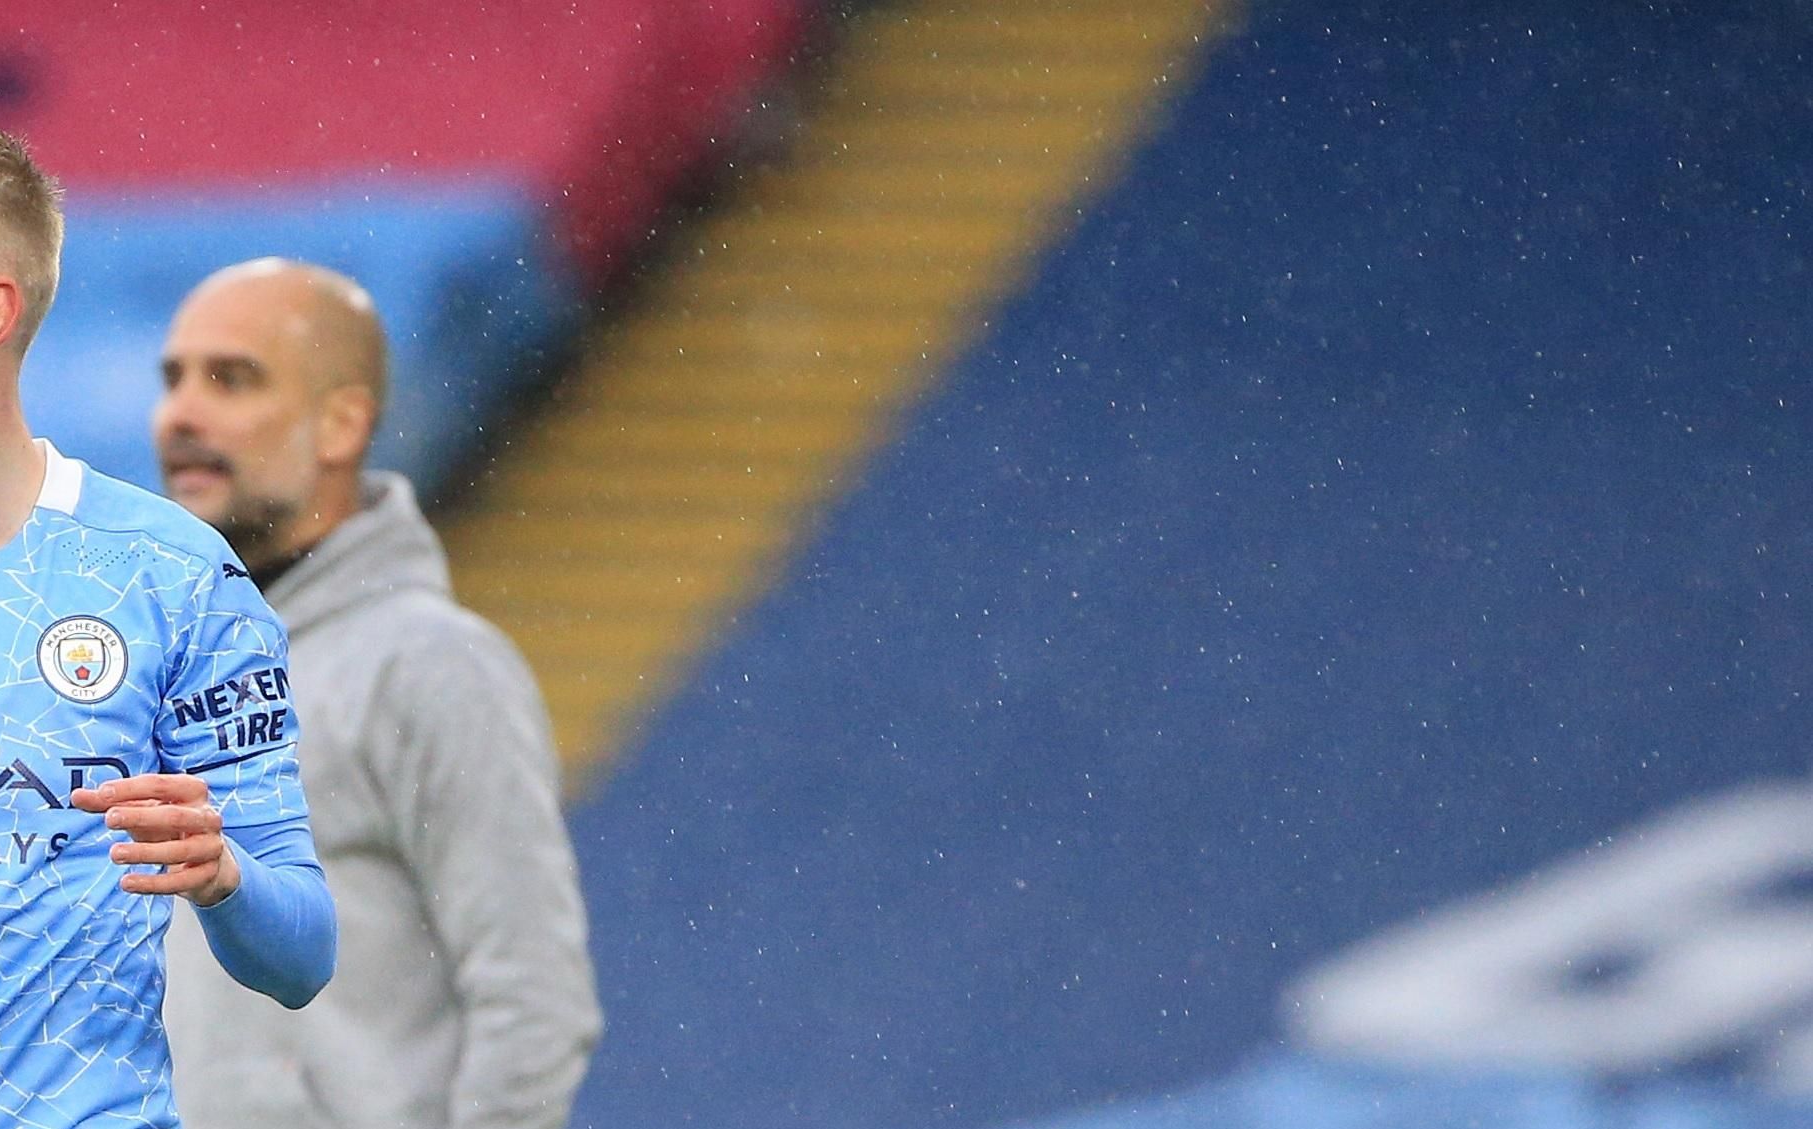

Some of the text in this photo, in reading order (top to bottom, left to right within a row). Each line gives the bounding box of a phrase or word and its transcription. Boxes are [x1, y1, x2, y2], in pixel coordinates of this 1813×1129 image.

[45, 622, 118, 649] MANCHESTER
[71, 688, 98, 698] CITY
[214, 708, 287, 751] TIRE
